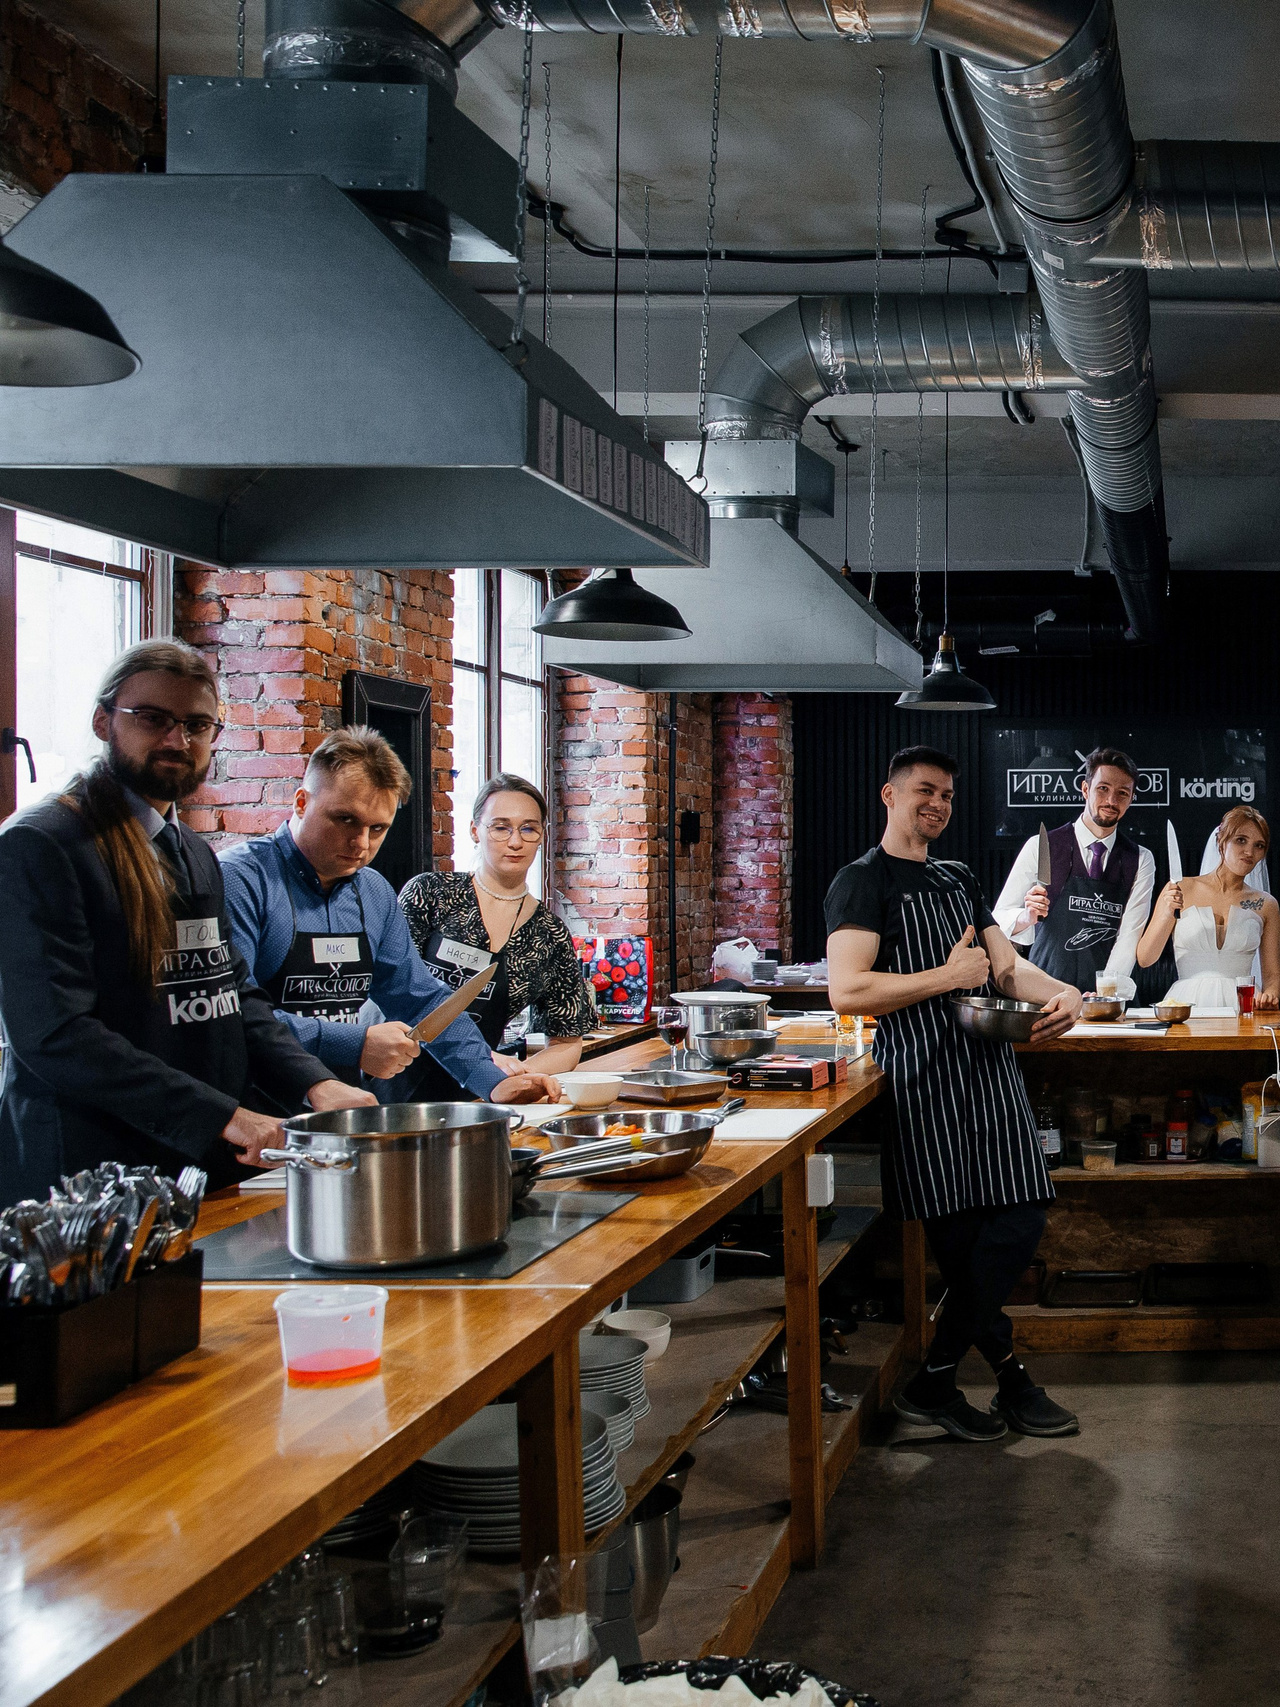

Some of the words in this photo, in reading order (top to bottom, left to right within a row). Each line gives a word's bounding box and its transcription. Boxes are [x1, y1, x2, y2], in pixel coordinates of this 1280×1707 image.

[1013, 774, 1069, 793] ИГРА
[1180, 777, 1255, 802] körting
[446, 946, 479, 965] НАСТЯ
